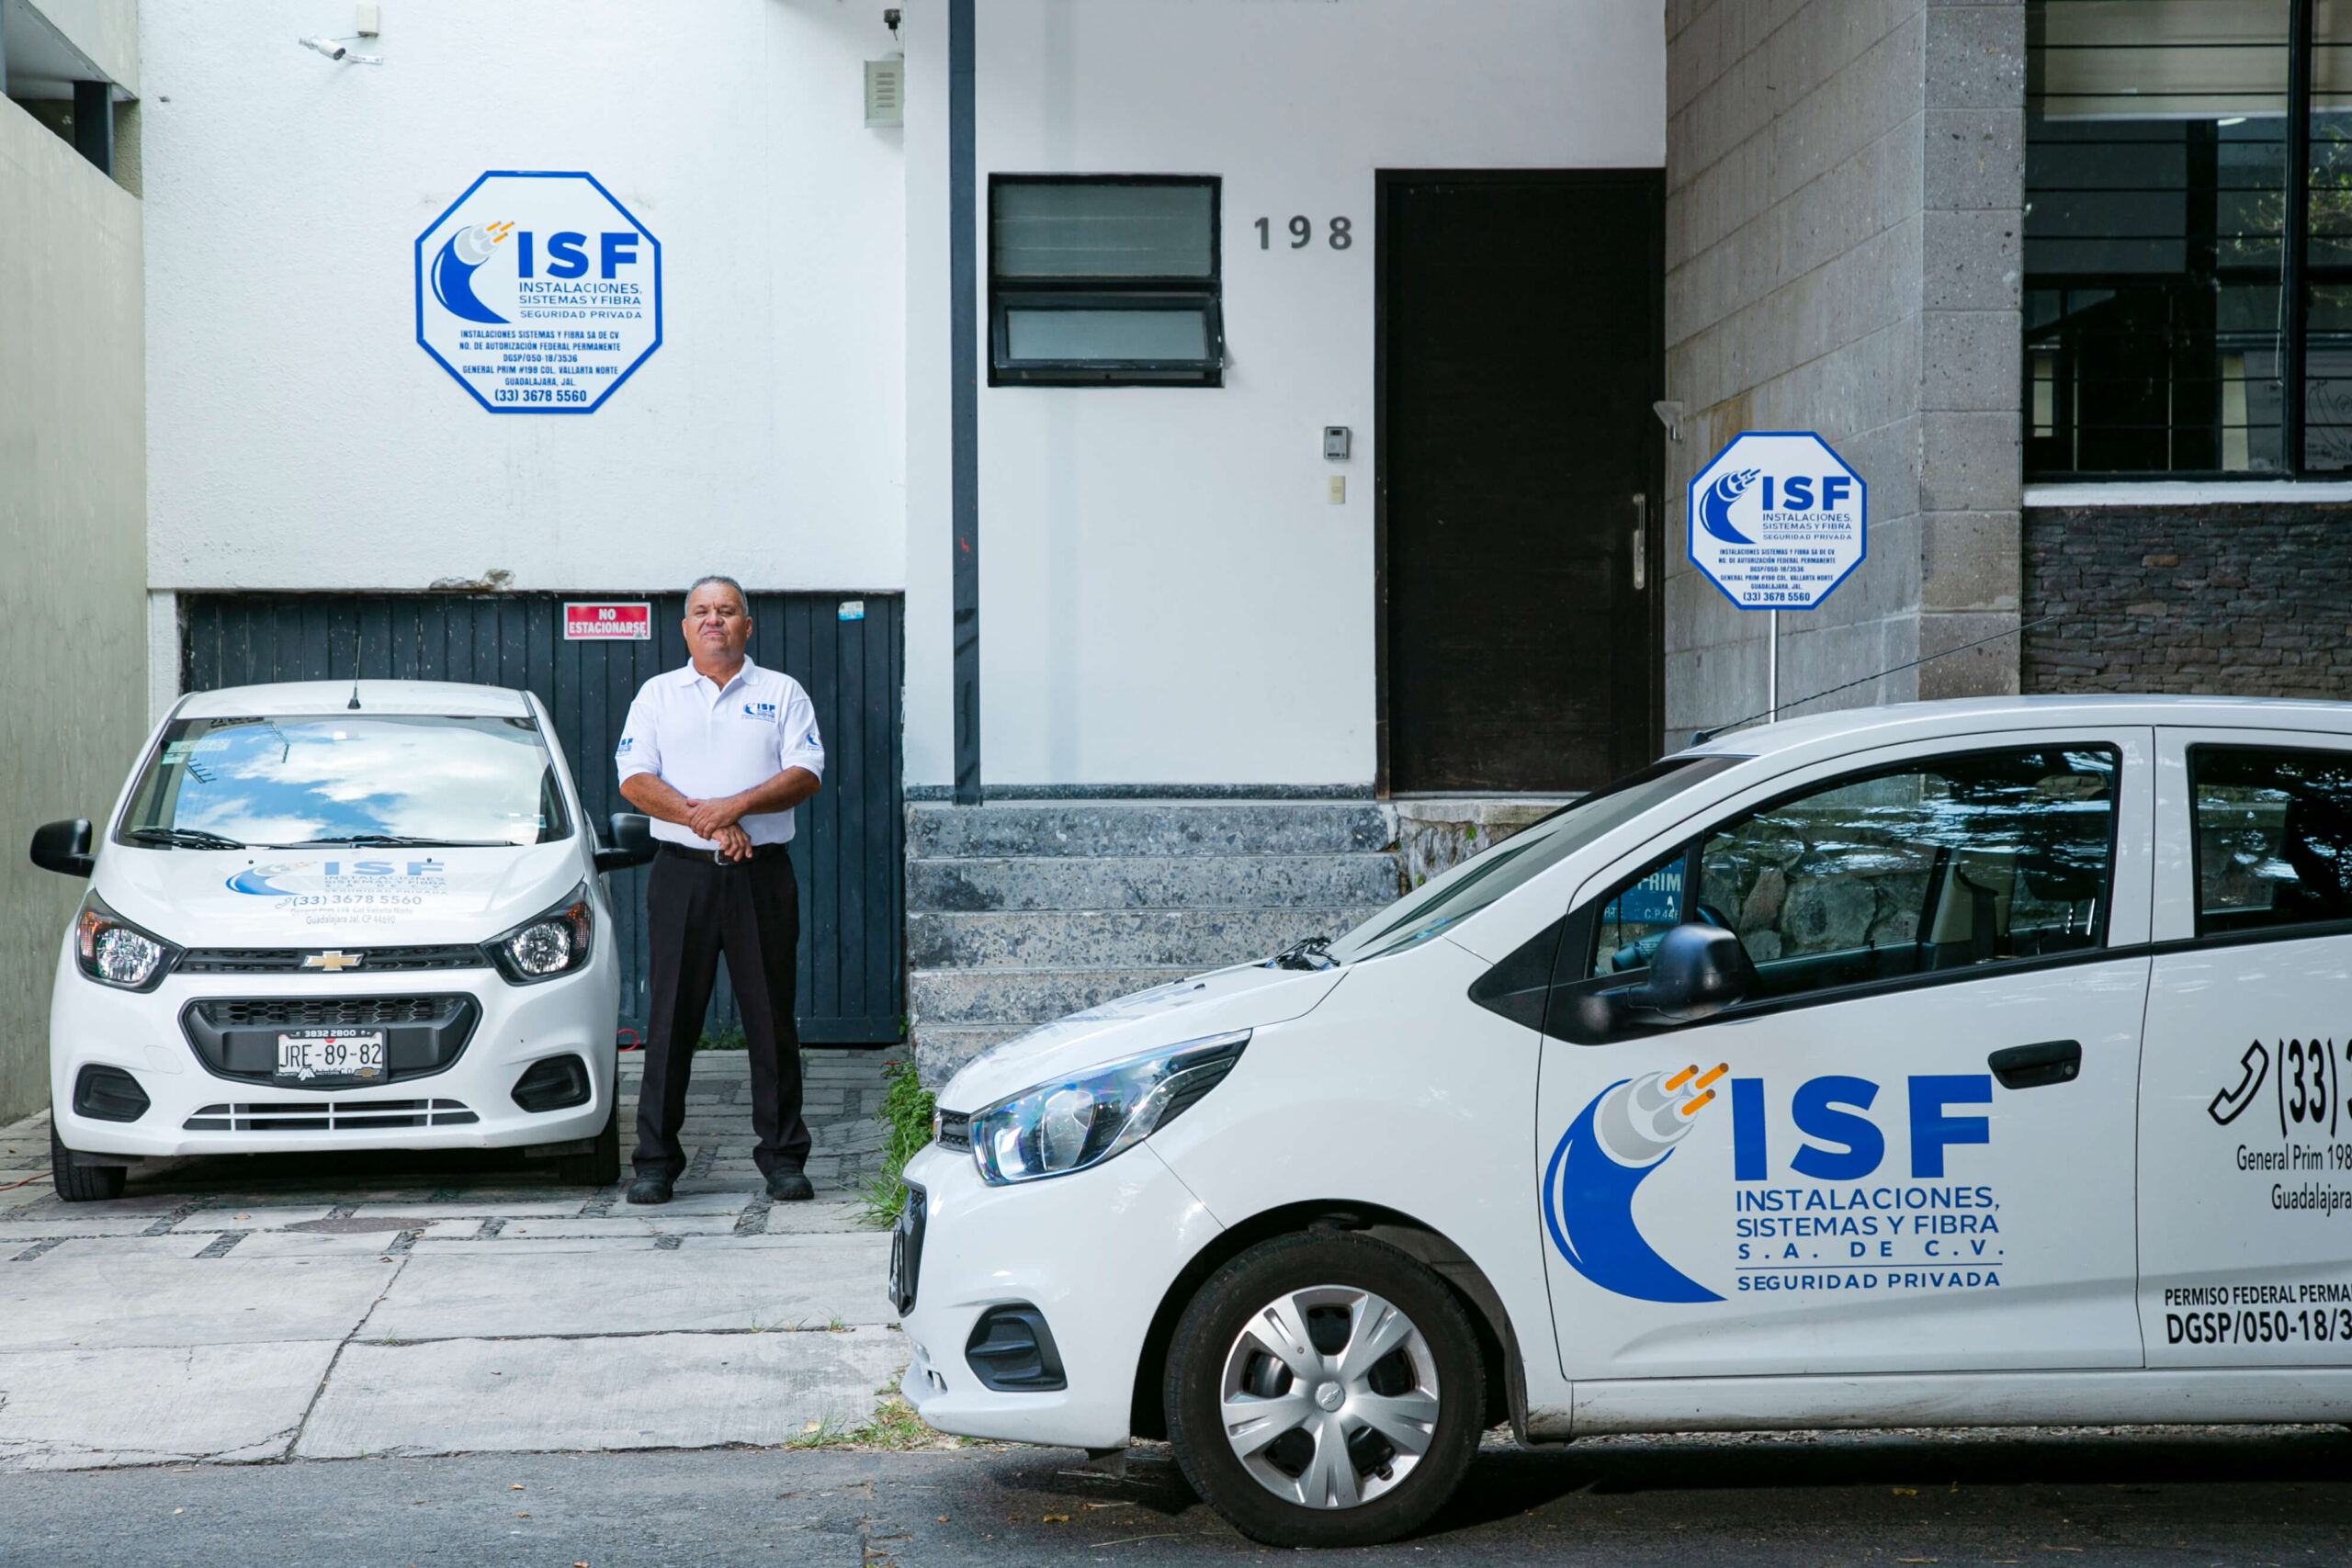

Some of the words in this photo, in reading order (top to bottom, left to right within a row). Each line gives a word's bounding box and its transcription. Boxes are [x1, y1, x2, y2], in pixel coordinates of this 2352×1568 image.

[1254, 214, 1352, 251] 198
[518, 231, 639, 279] ISF
[519, 295, 587, 304] SISTEMAS
[590, 296, 597, 304] Y
[601, 296, 641, 305] FIBRA
[590, 310, 642, 319] PRIVADA
[461, 330, 516, 338] INSTALACIONES
[518, 331, 555, 339] SISTEMAS
[558, 331, 561, 339] Y
[563, 331, 584, 339] FIBRA
[587, 331, 596, 339] SA
[598, 331, 607, 339] DE
[609, 331, 619, 339] CV
[459, 342, 471, 350] NO.
[474, 342, 482, 350] DE
[485, 341, 537, 351] AUTORIZACIÓN
[540, 343, 571, 351] FEDERAL
[573, 343, 620, 351] PERMANENTE
[462, 366, 494, 374] GENERAL
[497, 366, 516, 374] PRIM
[519, 366, 538, 374] #198
[559, 367, 594, 375] VALLARTA
[595, 367, 618, 375] NORTE
[504, 378, 559, 387] GUADALAJARA,
[494, 389, 519, 402] (33)
[523, 389, 552, 402] 3678
[556, 389, 587, 402] 5560
[1762, 476, 1851, 511] ISF
[1743, 592, 1761, 602] (33)
[1763, 592, 1785, 602] 3678
[1788, 592, 1810, 602] 5560
[598, 608, 616, 621] NO
[569, 621, 646, 634] ESTACIONARSE
[757, 703, 775, 712] ISF
[324, 861, 445, 876] ISF
[292, 896, 328, 907] (33)
[332, 895, 375, 904] 3678
[380, 896, 423, 905] 5560
[306, 915, 347, 926] Guadalajara
[279, 1043, 381, 1068] JRE-89-82
[2278, 1037, 2338, 1140] (33)
[1731, 1074, 1993, 1181] ISF
[2236, 1143, 2290, 1171] General
[2292, 1144, 2324, 1171] Prim
[2326, 1144, 2352, 1171] 198
[1736, 1186, 2001, 1213] INSTALACIONES,
[2271, 1182, 2352, 1217] Guadalajara
[1736, 1215, 1879, 1238] SISTEMAS
[1888, 1216, 1904, 1235] Y
[1914, 1214, 2000, 1235] FIBRA
[1737, 1274, 1878, 1292] SEGURIDAD
[1888, 1272, 2001, 1289] PRIVADA
[2165, 1287, 2230, 1306] PERMISO
[2233, 1285, 2297, 1304] FEDERAL
[2300, 1283, 2352, 1303] PERMA
[2165, 1308, 2352, 1345] DGSP/050-18/3
